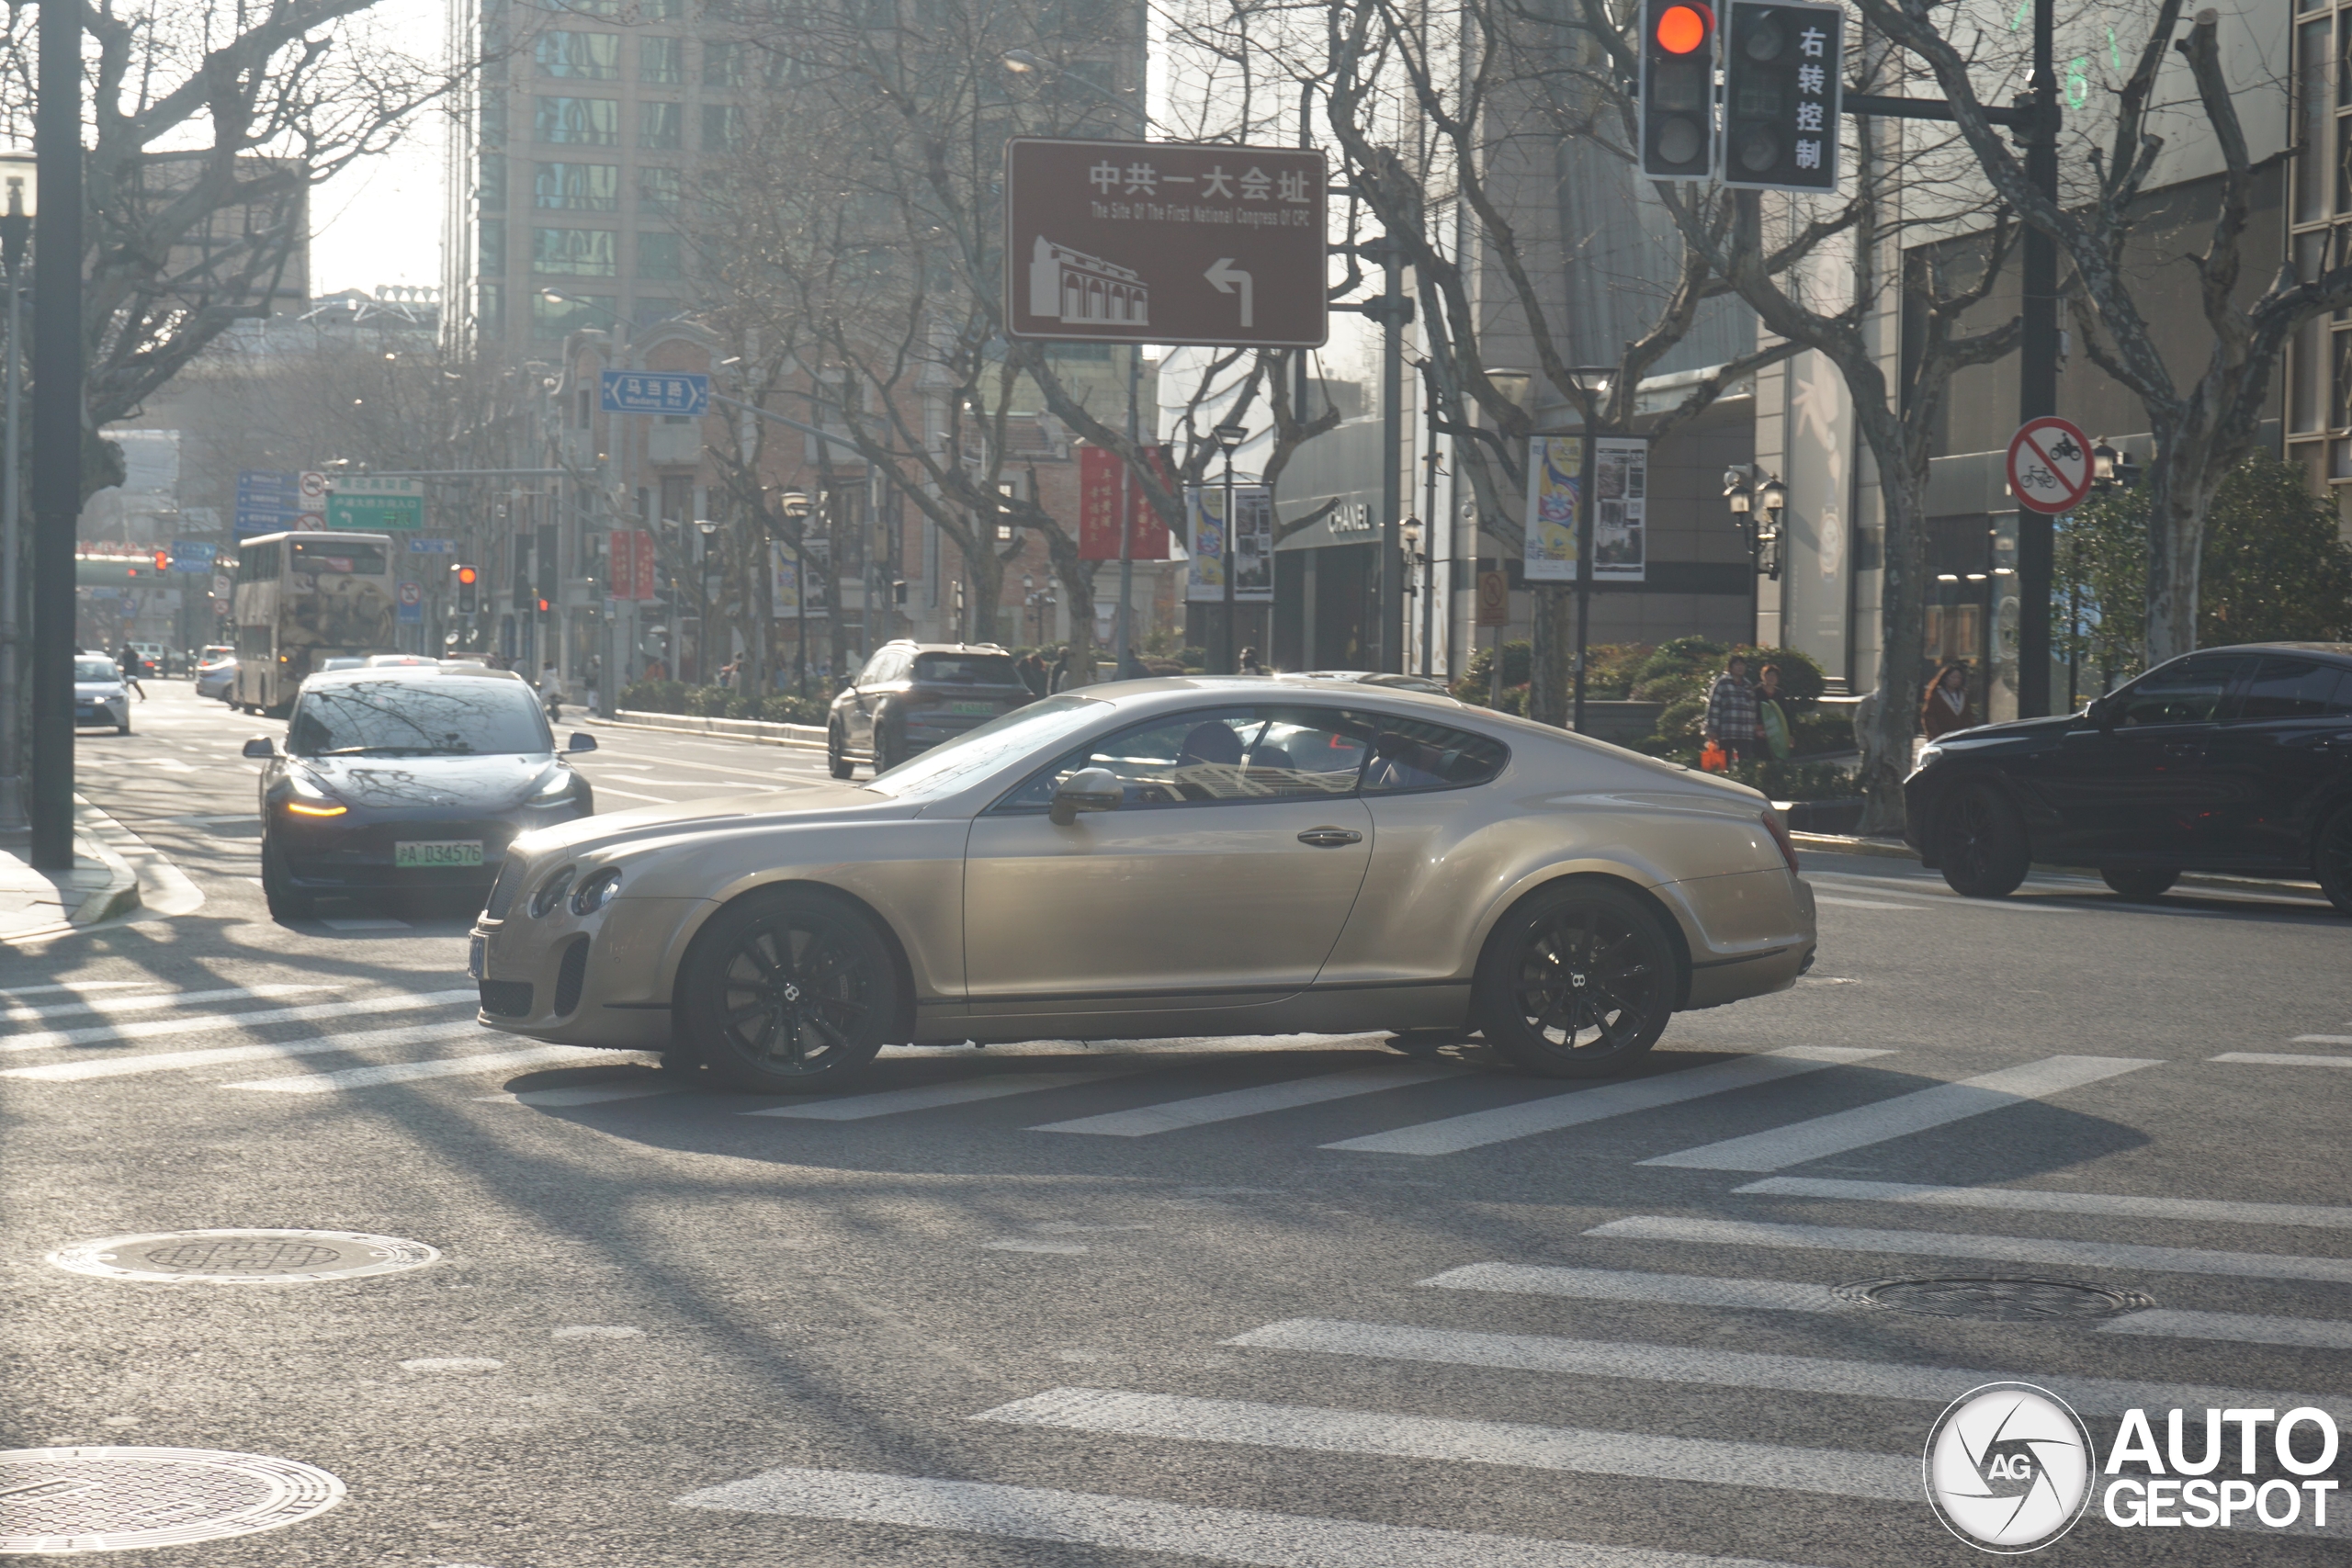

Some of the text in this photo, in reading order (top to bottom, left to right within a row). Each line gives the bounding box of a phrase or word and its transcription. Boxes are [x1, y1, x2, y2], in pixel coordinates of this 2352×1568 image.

[1795, 27, 1826, 169] 右转控制
[1090, 160, 1311, 203] 中共一大会址
[1091, 201, 1109, 219] The
[1148, 203, 1165, 220] The
[1193, 205, 1234, 223] National
[1236, 207, 1278, 230] Congress
[1293, 209, 1310, 227] CPC
[627, 378, 684, 398] 马当路
[1327, 503, 1371, 534] CHANEL
